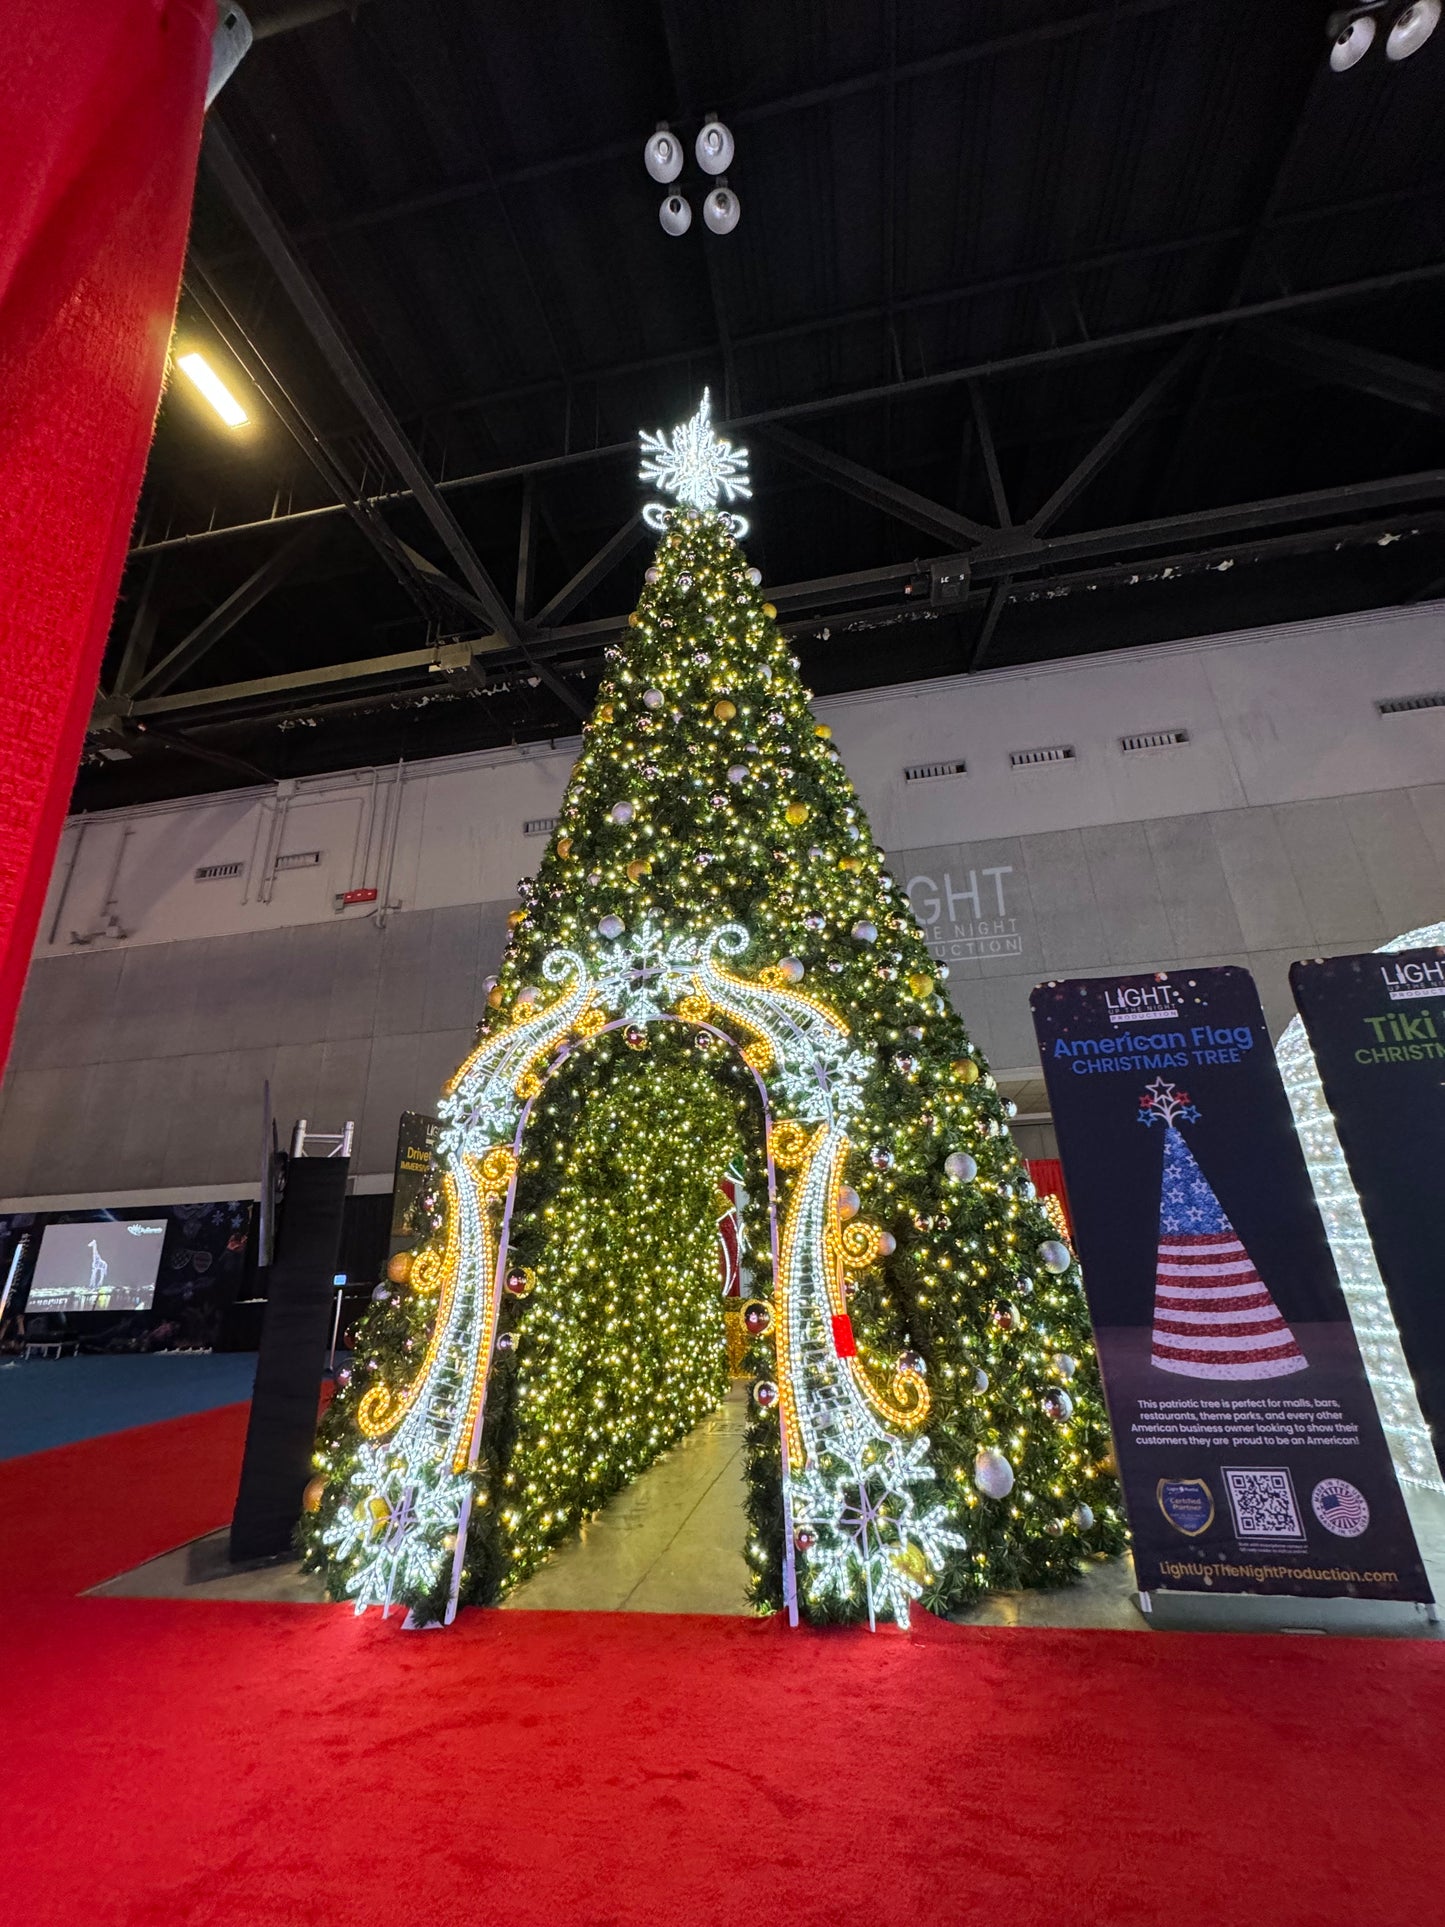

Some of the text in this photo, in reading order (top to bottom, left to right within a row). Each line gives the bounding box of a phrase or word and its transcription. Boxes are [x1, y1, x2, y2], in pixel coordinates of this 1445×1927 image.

[906, 866, 1013, 925] GHT
[955, 918, 1017, 938] NIGHT
[935, 939, 1017, 957] UCTION
[1381, 960, 1445, 986] LIGH
[1104, 985, 1172, 1009] LIGHT
[1391, 988, 1445, 998] PRODUCT
[1111, 1011, 1177, 1021] PRODUCTION
[1147, 1004, 1176, 1012] NIGHT
[1363, 1010, 1438, 1043] Tiki
[1054, 1025, 1254, 1057] American Flag
[1072, 1047, 1241, 1075] CHRISTMAS TREE
[1137, 1398, 1341, 1410] This patriotic tree is perfect for malls, bars,
[1140, 1411, 1343, 1422] restaurants, theme parks, and every other
[1131, 1422, 1359, 1435] American business owner looking to show their
[1135, 1435, 1360, 1447] customers they are proud to be an American!
[1160, 1561, 1399, 1582] LightUpTheNightProduction.com
